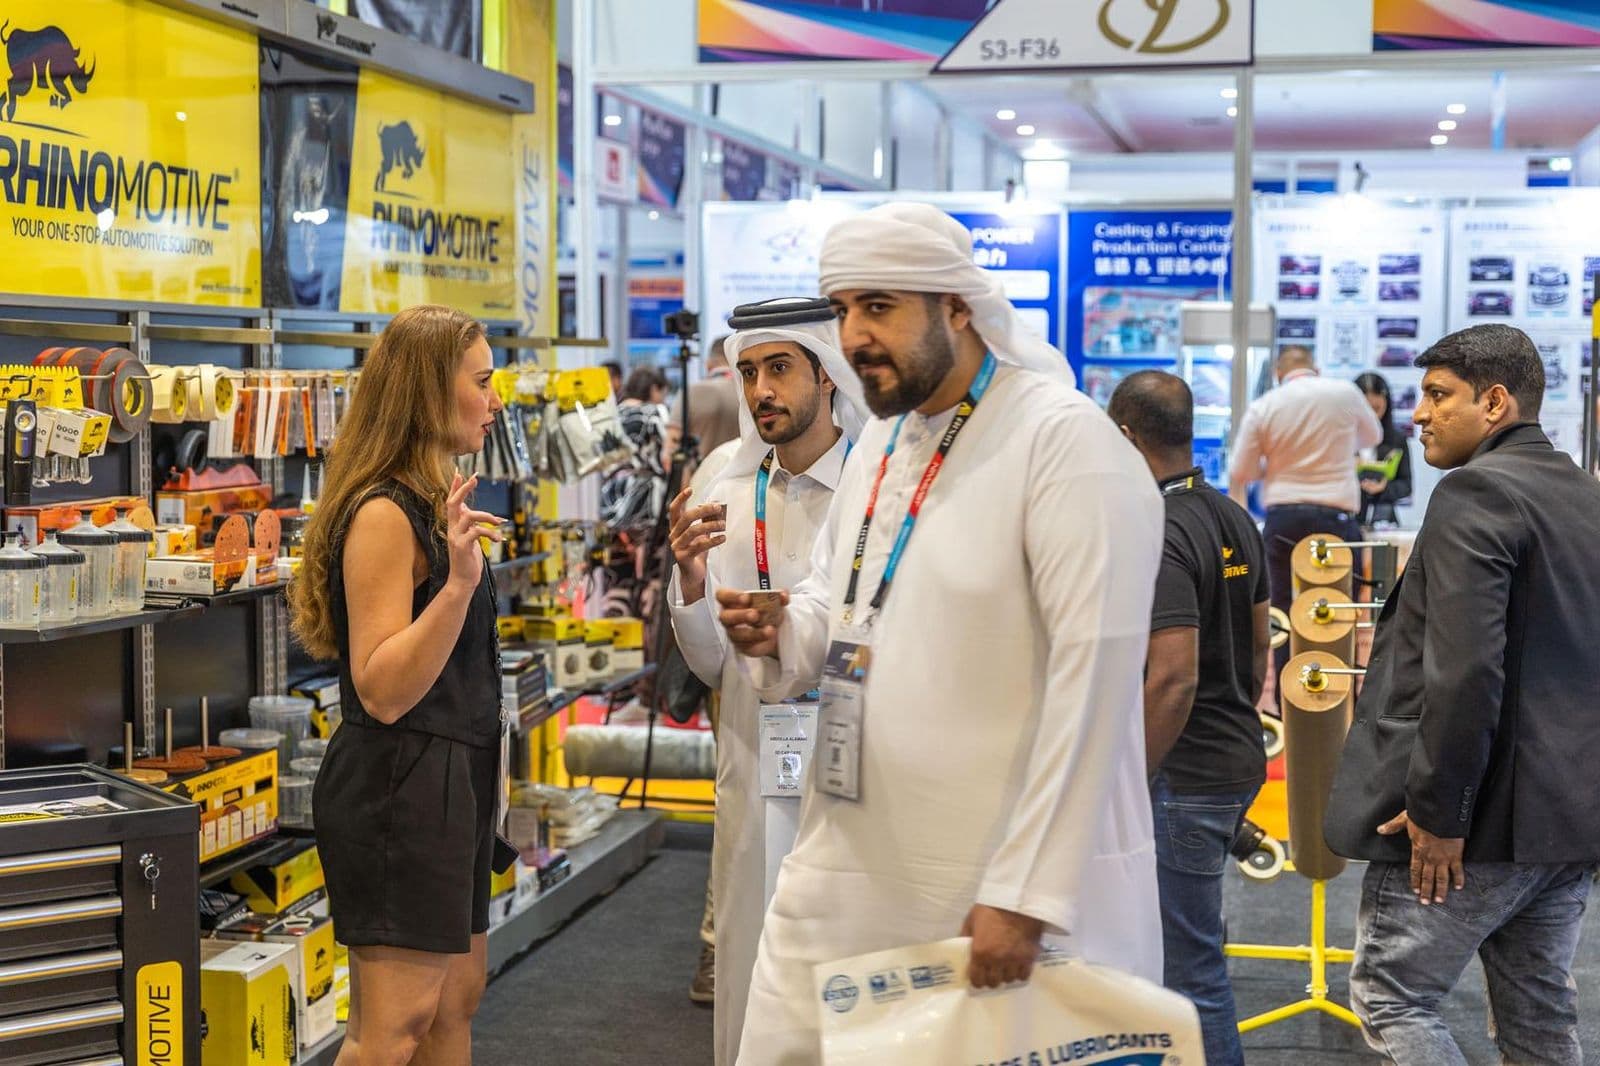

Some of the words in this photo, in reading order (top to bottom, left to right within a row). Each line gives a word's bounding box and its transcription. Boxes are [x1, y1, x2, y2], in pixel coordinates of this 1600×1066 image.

[980, 38, 1060, 60] S3-F36
[12, 216, 45, 239] YOUR
[46, 221, 101, 244] ONE-STOP
[102, 229, 168, 252] AUTOMOTIVE
[169, 236, 214, 256] SOLUTION
[1047, 1033, 1173, 1065] LUBRICANTS
